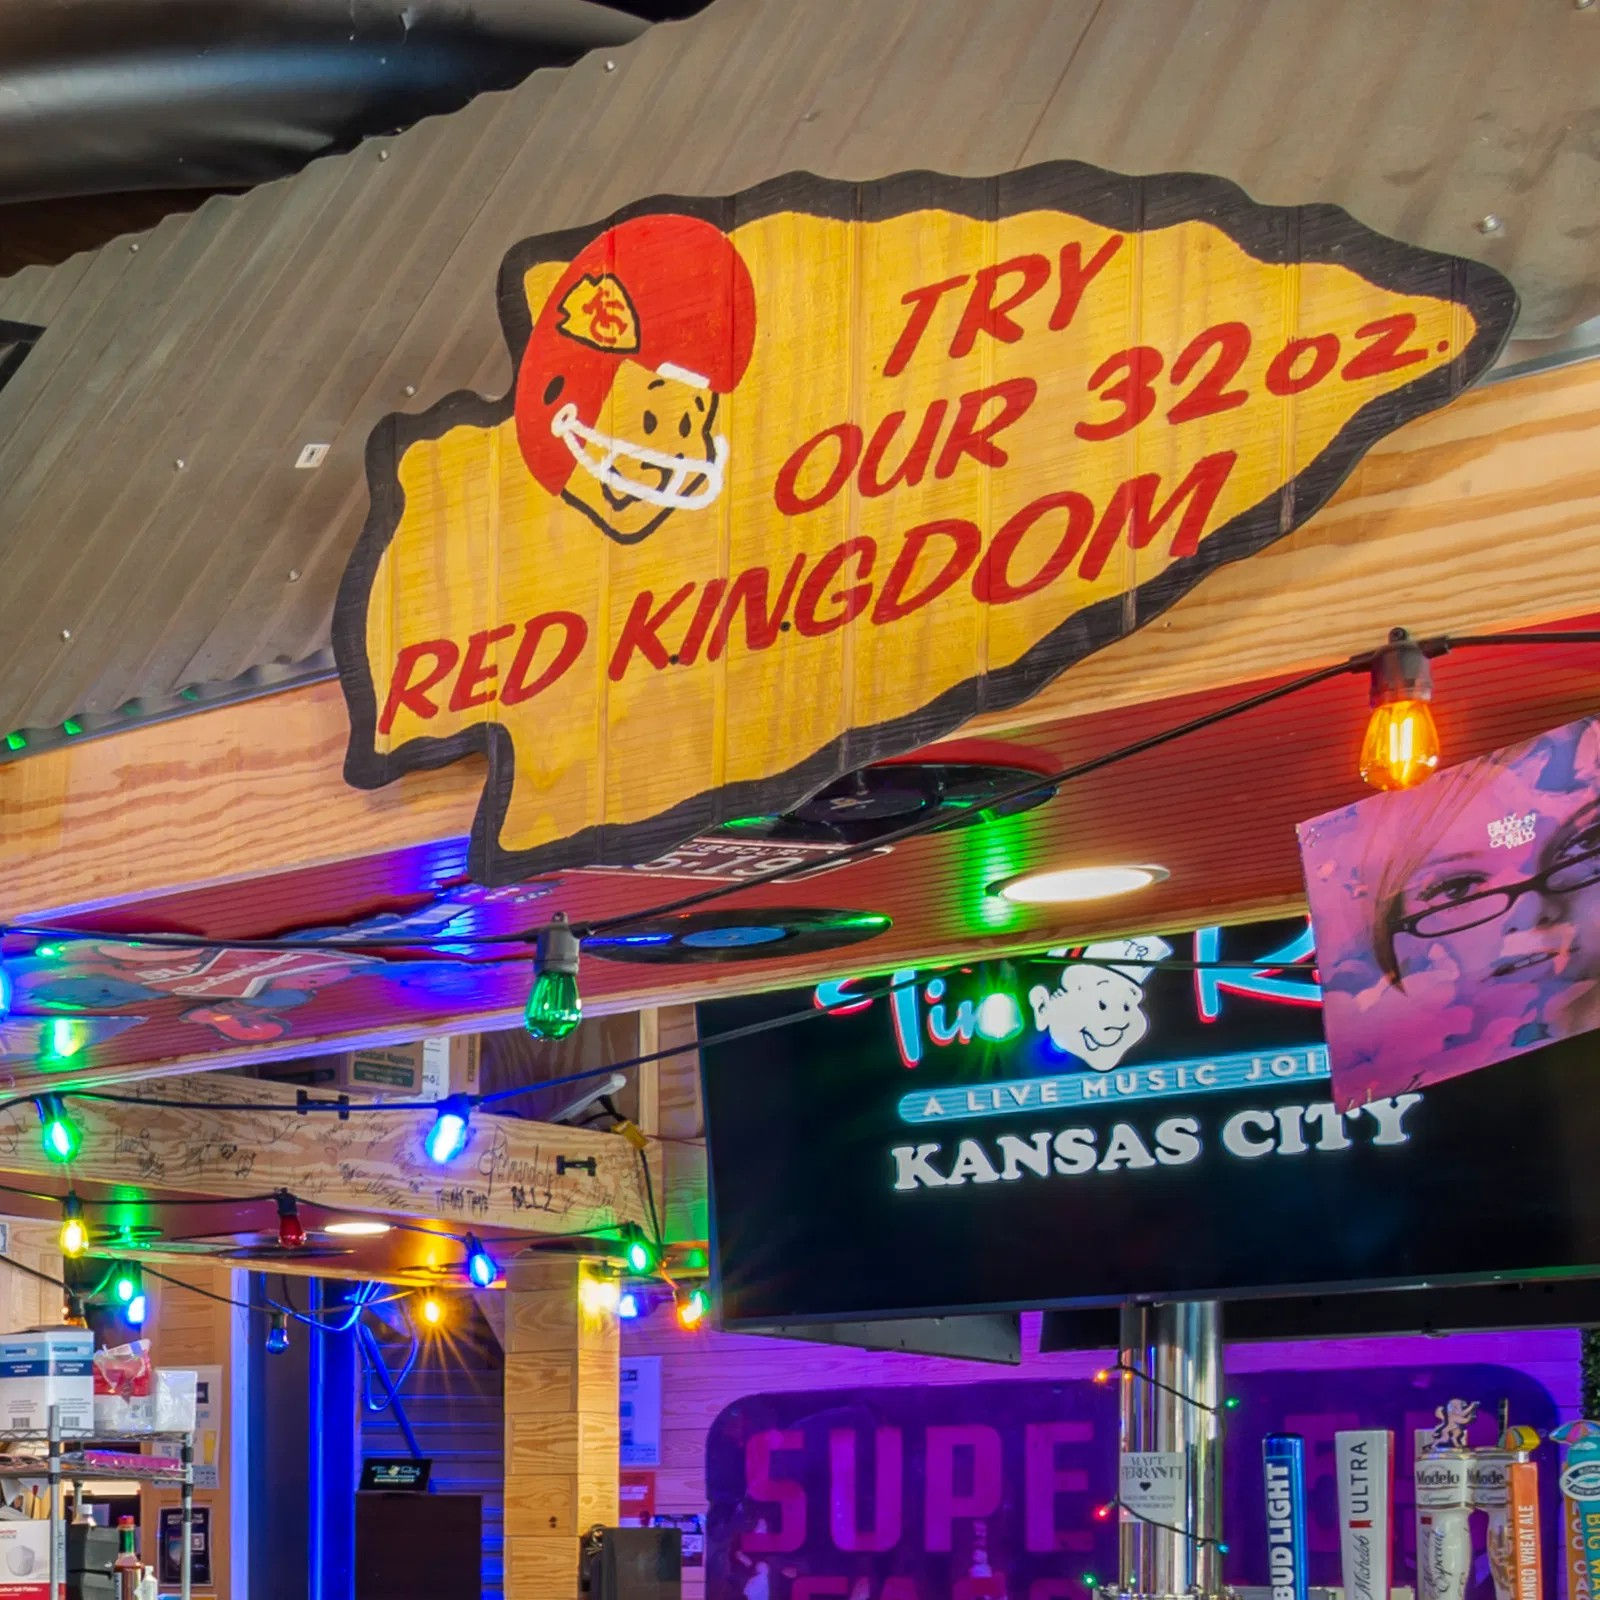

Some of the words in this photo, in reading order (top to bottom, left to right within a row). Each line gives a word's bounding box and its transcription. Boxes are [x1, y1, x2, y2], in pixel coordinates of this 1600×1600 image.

[883, 236, 1125, 378] TRY
[772, 375, 1038, 519] OUR
[377, 610, 588, 737] RED
[606, 450, 1238, 685] KINGDOM
[924, 1096, 945, 1116] A
[967, 1080, 1060, 1113] LIVE
[1082, 1065, 1218, 1100] MUSIC
[1245, 1050, 1331, 1082] JOI
[891, 1117, 1201, 1191] KANSAS
[1223, 1093, 1424, 1158] CITY
[1266, 1463, 1292, 1543] LIGHT
[1350, 1440, 1369, 1515] ULTRA
[1416, 1471, 1460, 1484] Modelo
[1519, 1504, 1535, 1525] ALE
[1519, 1527, 1537, 1567] WHEAT
[1586, 1513, 1600, 1550] BIG
